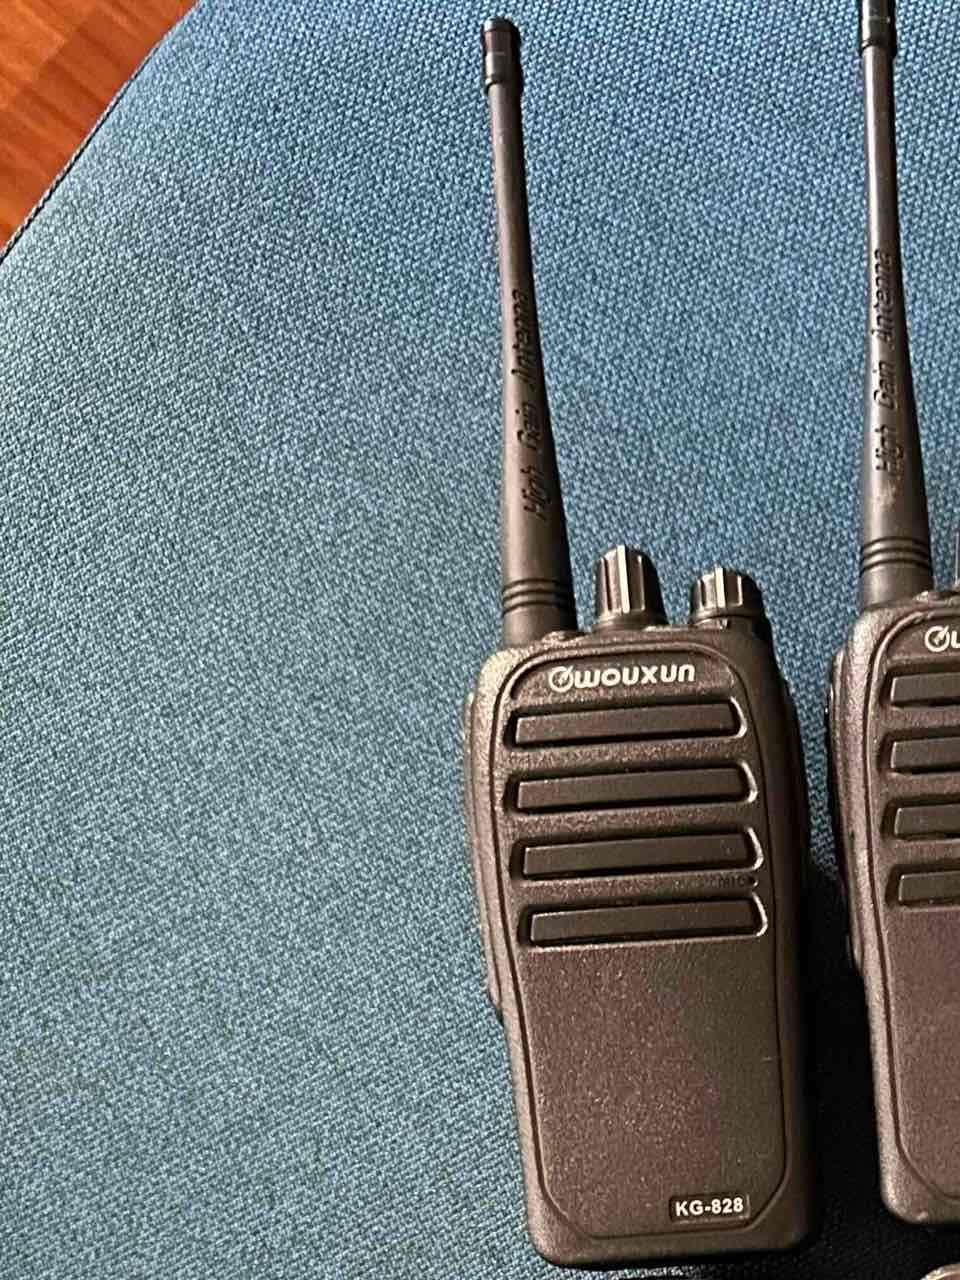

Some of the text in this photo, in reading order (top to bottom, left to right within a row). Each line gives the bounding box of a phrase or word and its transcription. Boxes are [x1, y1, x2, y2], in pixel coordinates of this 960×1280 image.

[871, 249, 896, 350] Antenna
[873, 359, 897, 411] Gain
[675, 1197, 743, 1216] KG-828
